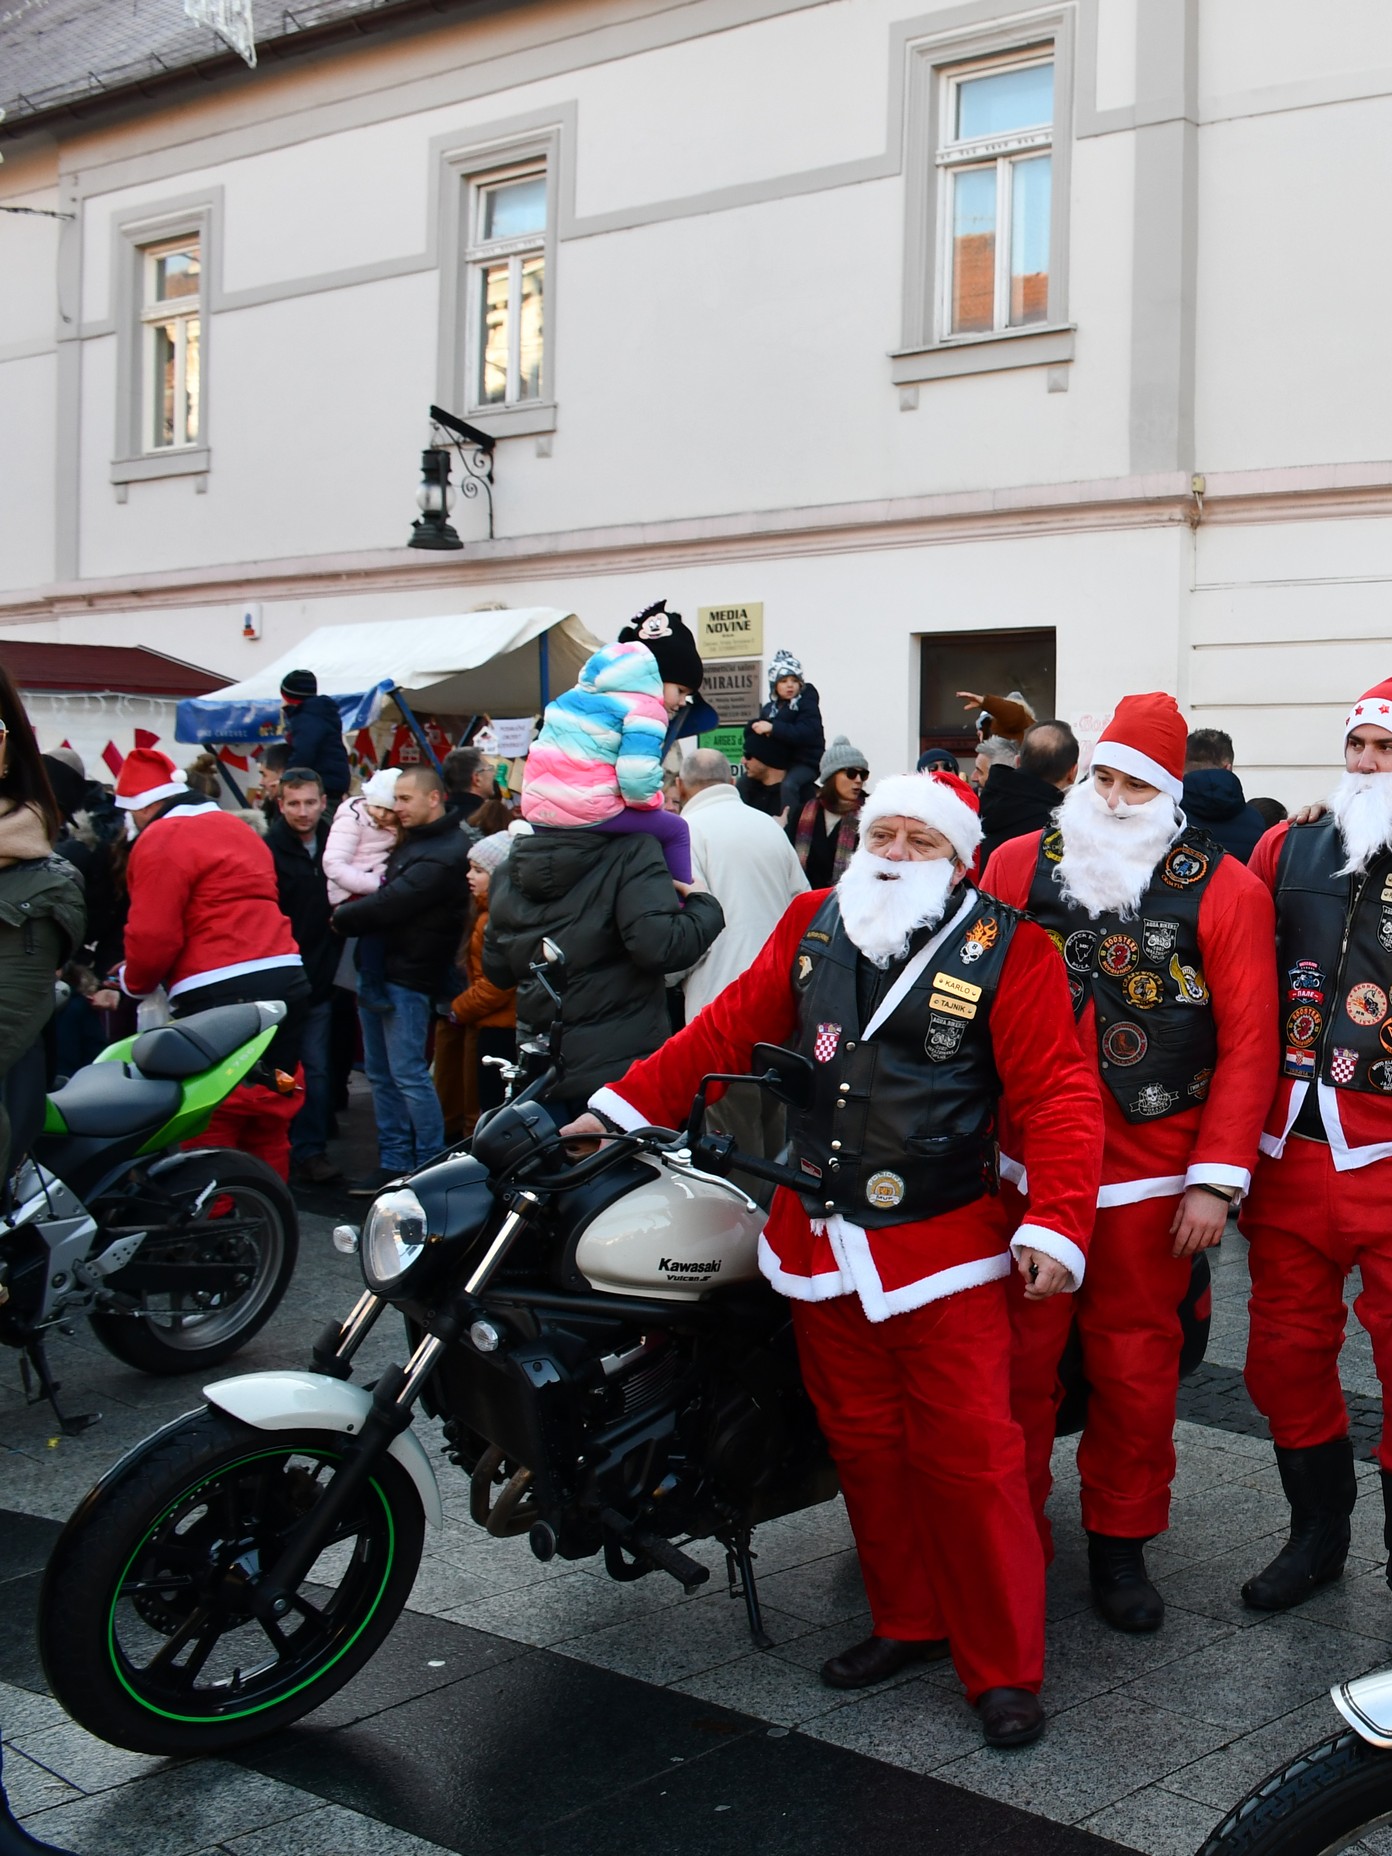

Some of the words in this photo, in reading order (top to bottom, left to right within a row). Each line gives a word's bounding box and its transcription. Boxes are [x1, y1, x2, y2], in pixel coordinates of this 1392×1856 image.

[709, 609, 748, 621] MEDIA
[706, 620, 751, 634] NOVINE
[1104, 936, 1138, 952] ROOSTERS
[1071, 961, 1090, 969] PULA
[945, 980, 970, 994] KARLO
[941, 1000, 966, 1012] TAJNIK
[868, 1171, 903, 1187] POLICIJA
[658, 1258, 721, 1272] Kawasaki
